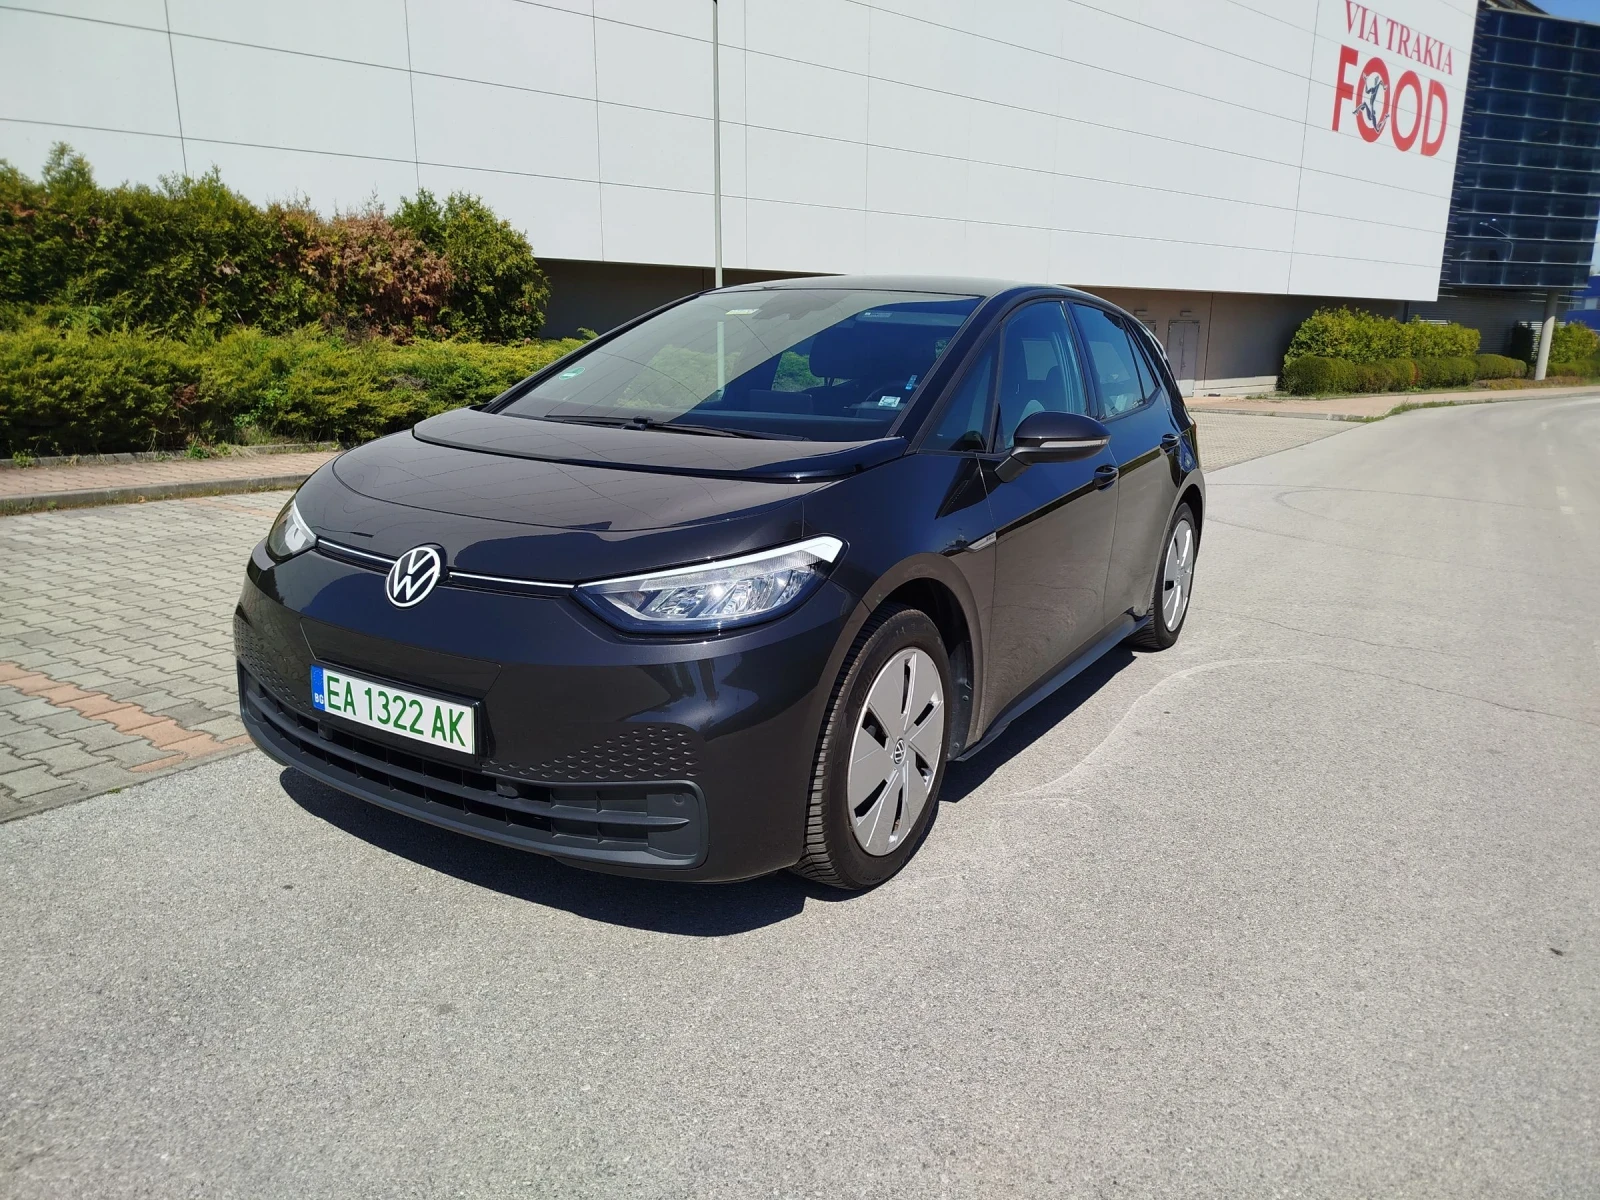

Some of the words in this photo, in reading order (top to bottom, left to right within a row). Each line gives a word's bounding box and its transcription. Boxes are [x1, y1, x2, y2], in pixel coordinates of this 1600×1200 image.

[1345, 0, 1380, 46] VIA
[1386, 18, 1453, 76] TRAKIA
[1332, 44, 1448, 156] FOOD
[314, 692, 324, 704] BG
[327, 675, 357, 716] EA
[364, 687, 424, 736] 1322
[431, 705, 466, 747] AK
